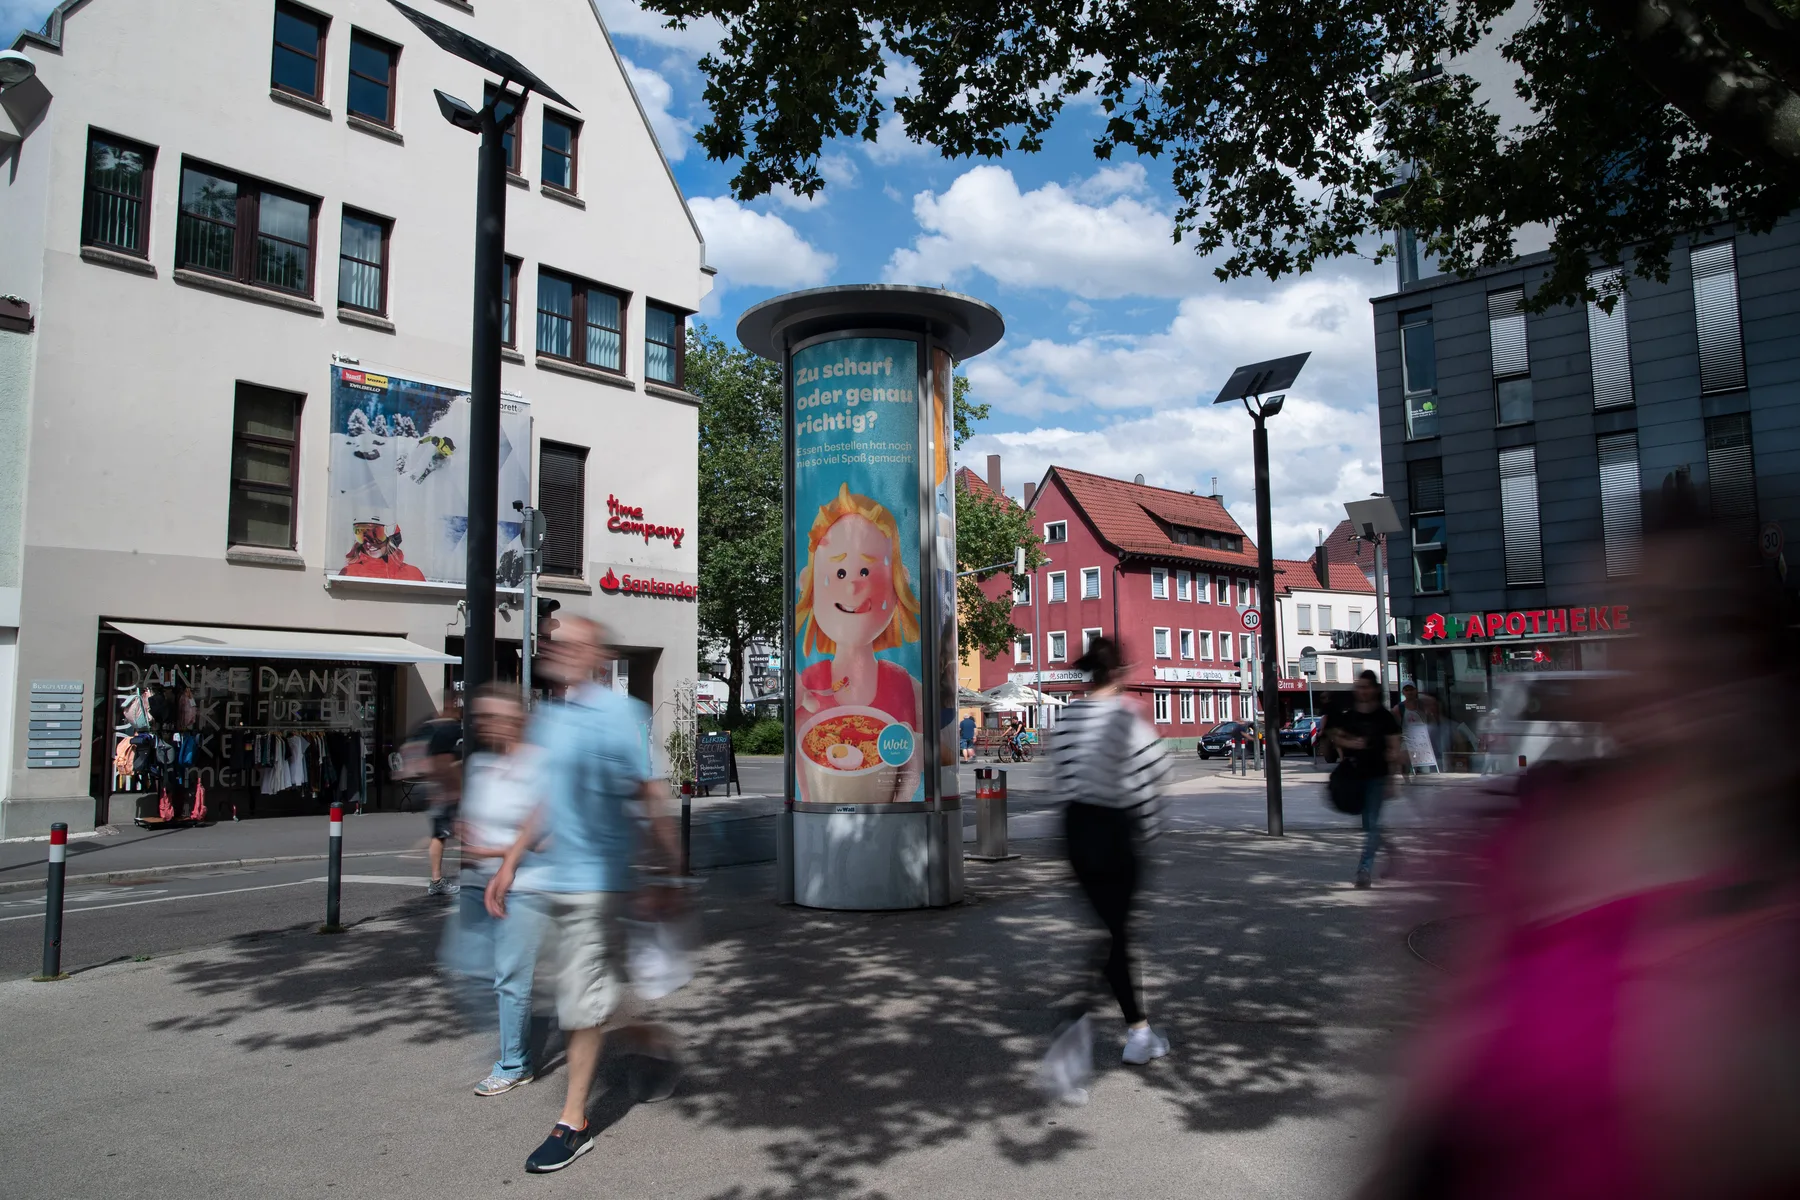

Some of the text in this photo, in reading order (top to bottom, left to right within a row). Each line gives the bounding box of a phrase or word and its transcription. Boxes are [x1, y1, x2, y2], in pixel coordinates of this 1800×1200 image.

[797, 356, 893, 386] Zu scharf
[797, 387, 913, 410] oder genau
[797, 409, 878, 435] richtig?
[797, 440, 912, 456] Essen bestellen hat noch
[796, 453, 914, 468] nie so viel Spaß gemacht.
[607, 494, 644, 517] time
[607, 516, 685, 546] Company
[1764, 532, 1778, 549] 30
[622, 574, 700, 597] Santander
[1245, 614, 1258, 625] 30
[1465, 605, 1631, 639] APOTHEKE
[114, 660, 250, 692] DANKE
[259, 666, 373, 694] DANKE
[1056, 671, 1083, 680] sanbao
[257, 696, 302, 721] FÜR
[321, 699, 376, 721] EURE
[883, 738, 909, 750] Wolt
